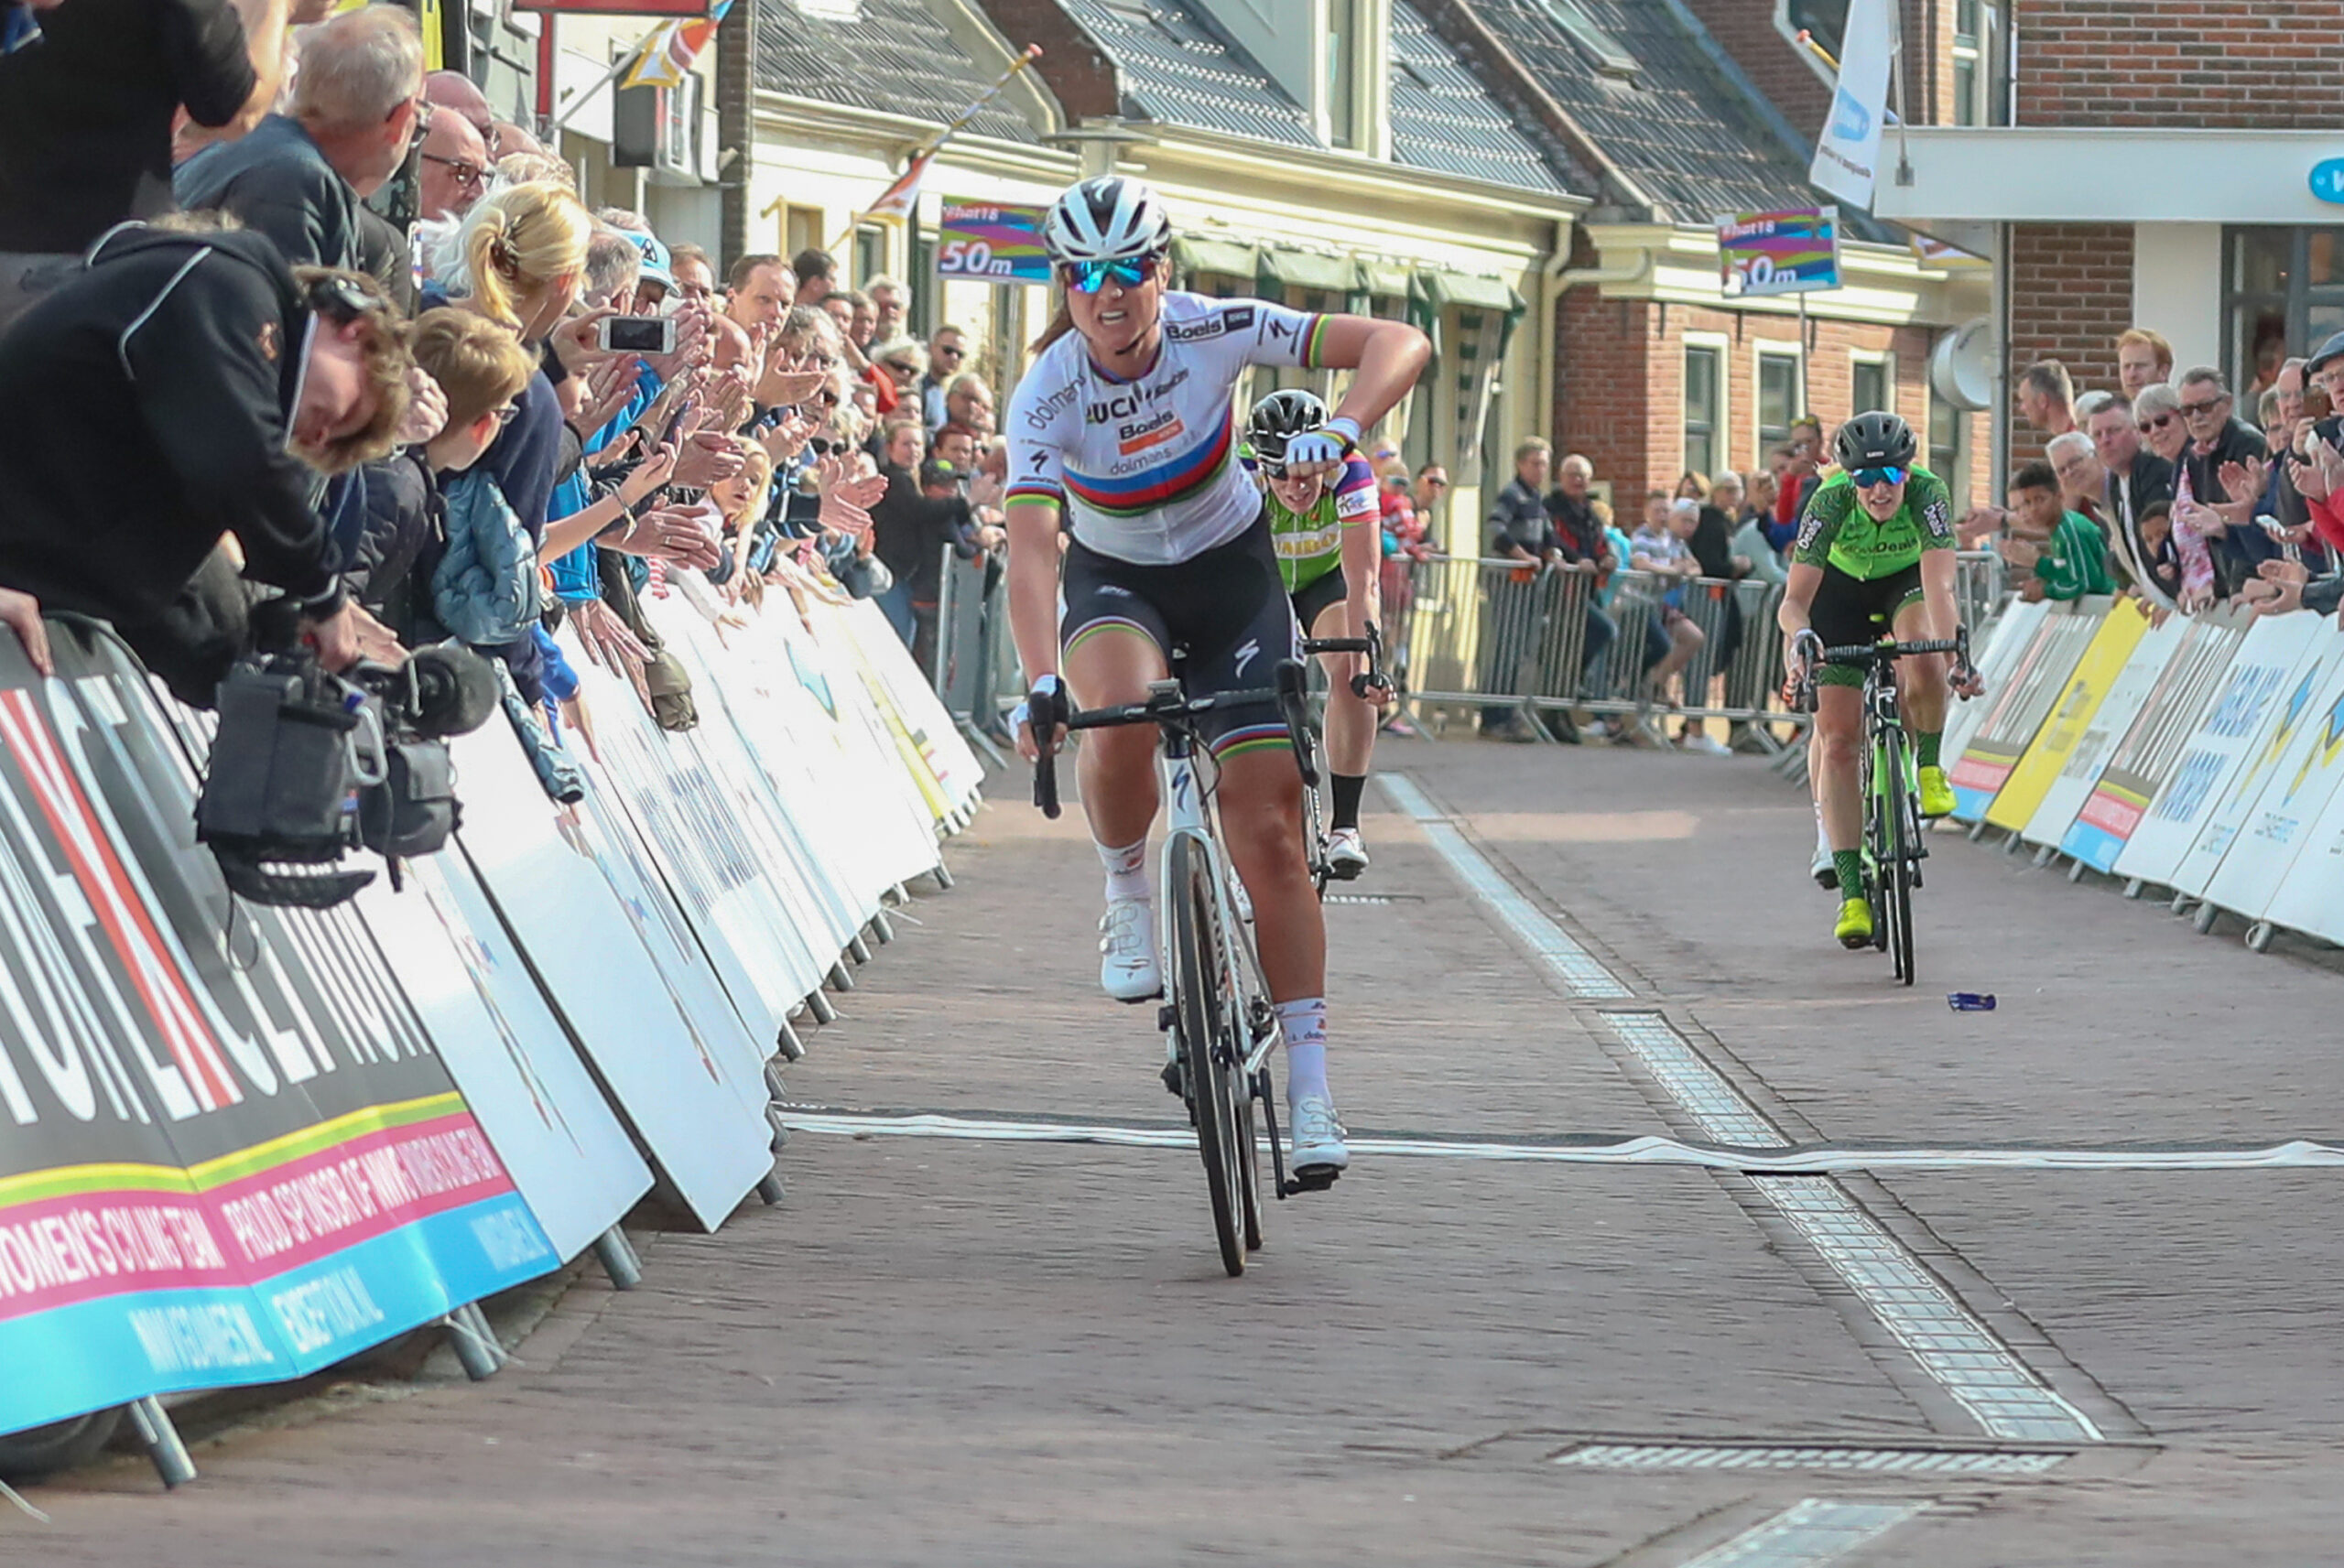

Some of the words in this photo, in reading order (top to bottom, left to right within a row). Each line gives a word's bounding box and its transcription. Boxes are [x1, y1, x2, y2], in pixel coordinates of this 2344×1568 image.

[1166, 319, 1222, 340] Boels
[1119, 409, 1175, 440] Boels
[1110, 448, 1174, 476] dolmans
[222, 1191, 294, 1263] PROUD
[271, 1165, 363, 1244] SPONSOR
